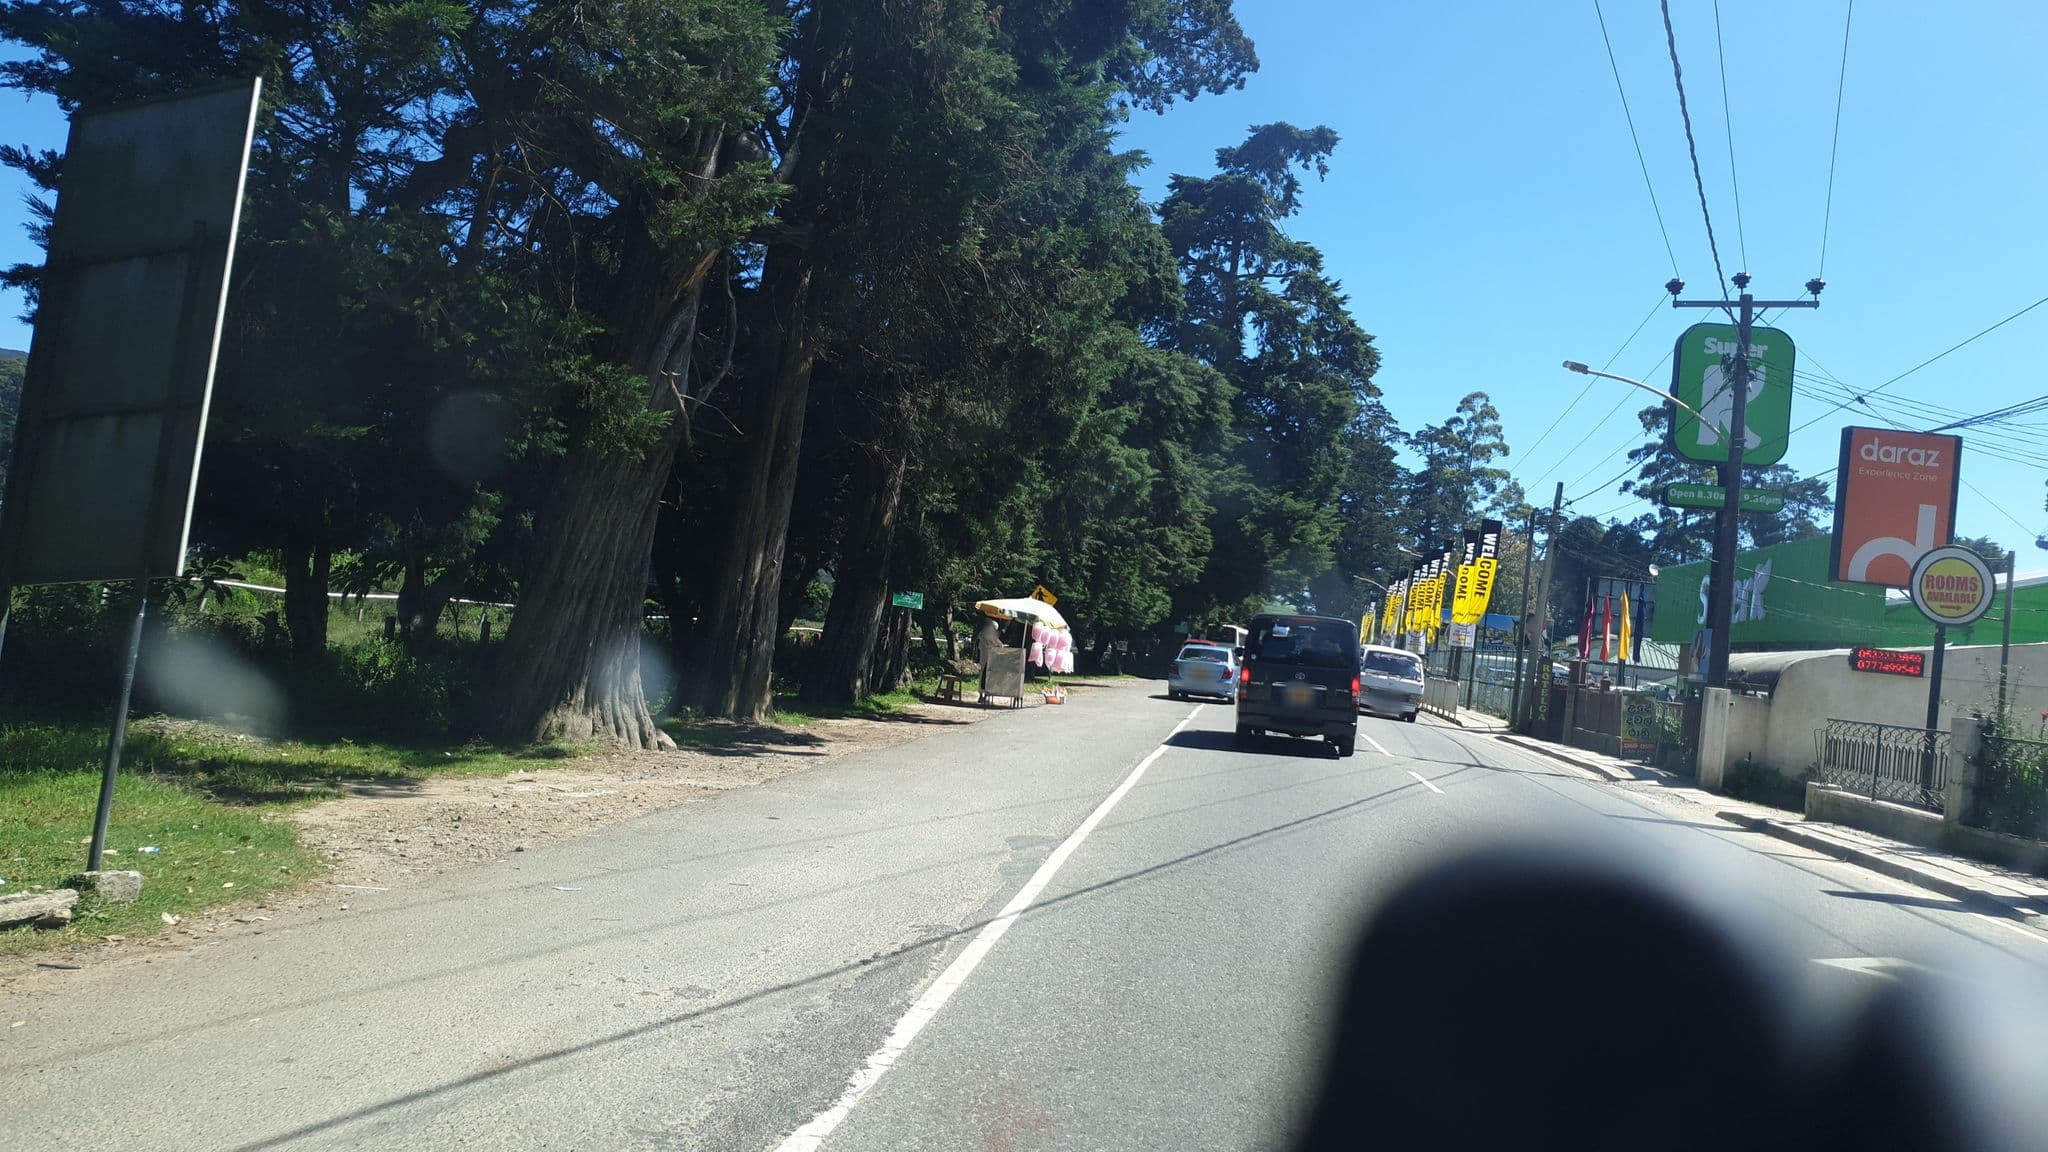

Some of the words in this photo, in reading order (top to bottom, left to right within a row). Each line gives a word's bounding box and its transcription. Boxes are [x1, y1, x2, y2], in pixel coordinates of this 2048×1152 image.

[1860, 437, 1940, 467] daraz
[1858, 466, 1911, 481] Experience
[1912, 471, 1938, 482] Zone
[1669, 488, 1695, 499] Open
[1456, 542, 1476, 600] WELCOME
[1474, 533, 1498, 599] WELCOME
[1926, 574, 1978, 592] ROOMS
[1927, 591, 1977, 604] AVAILABLE
